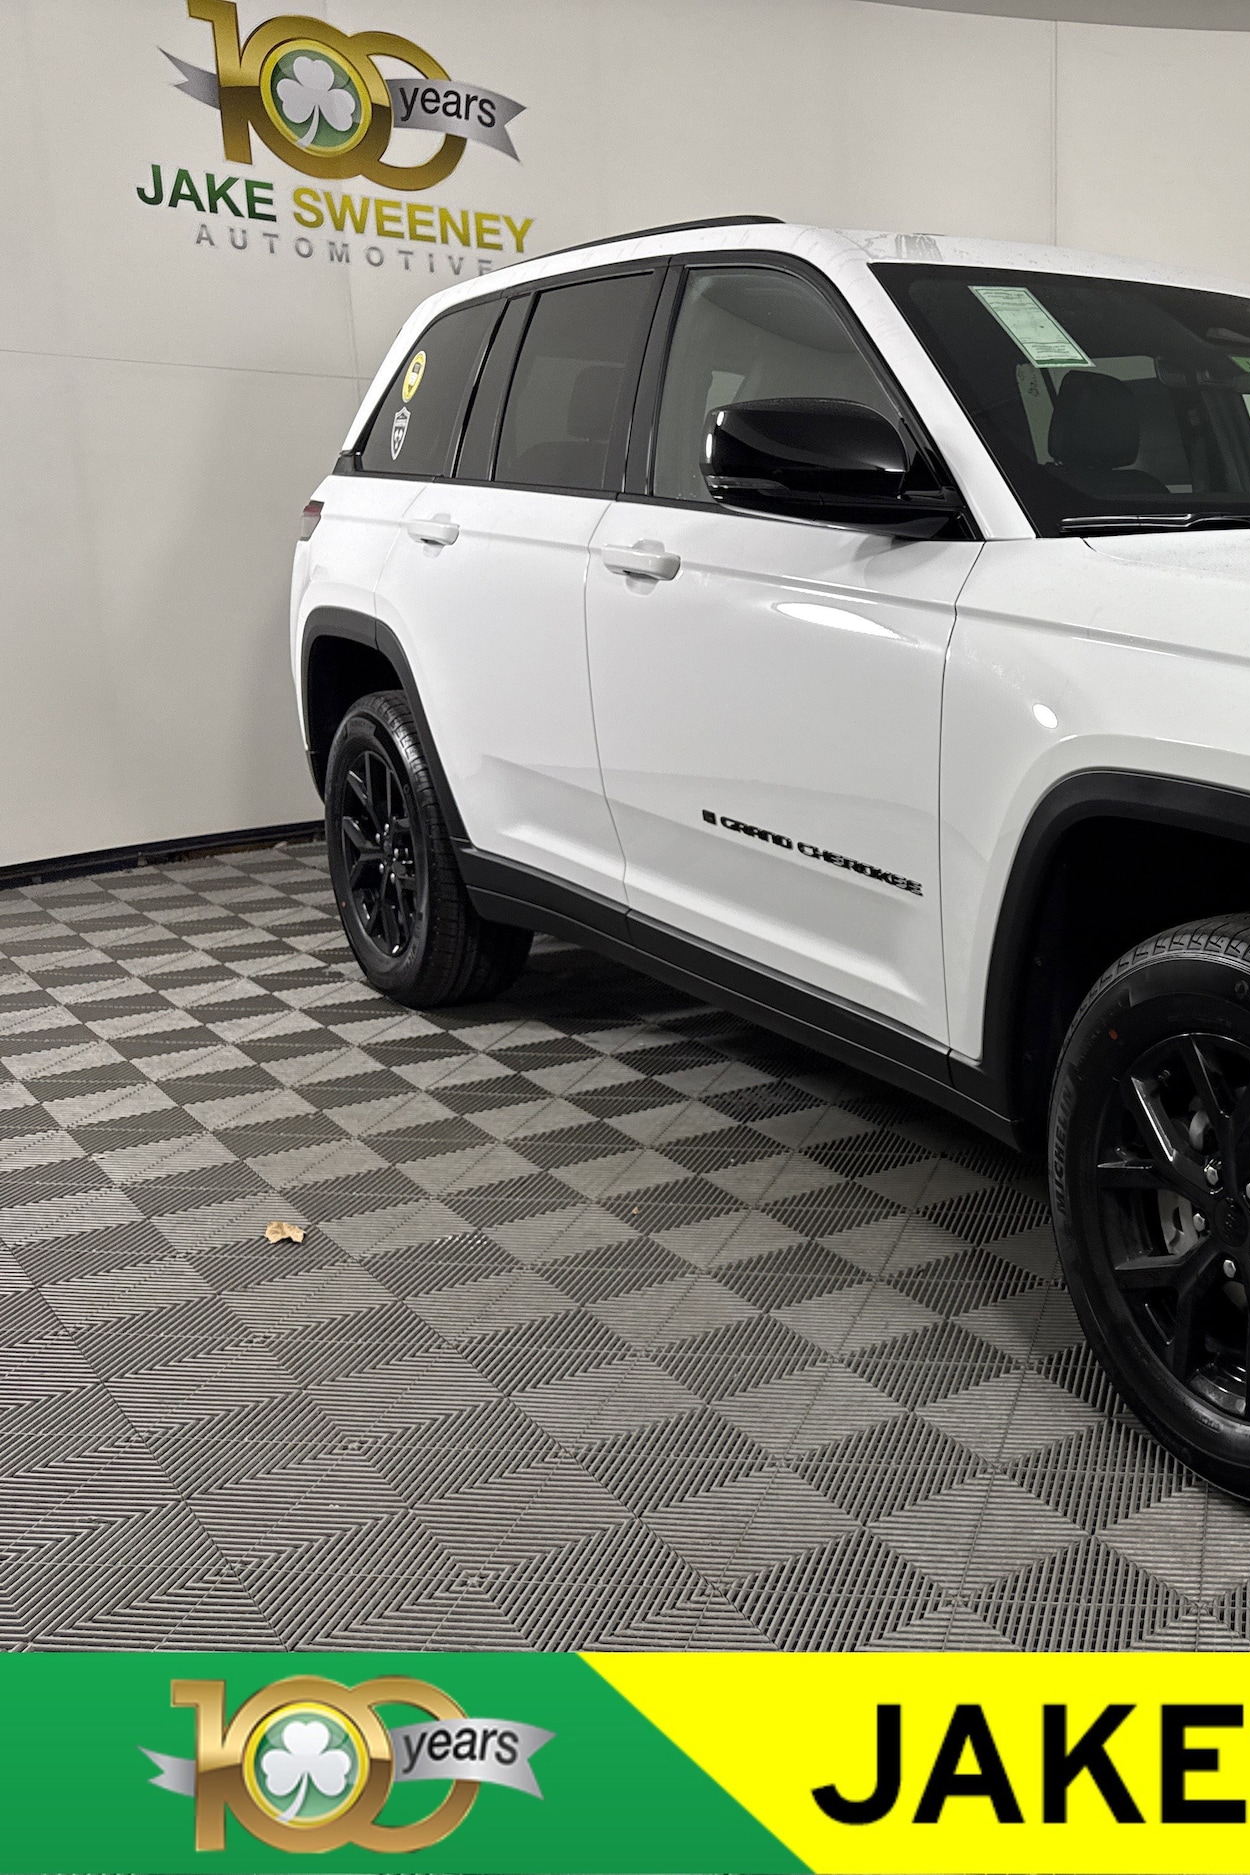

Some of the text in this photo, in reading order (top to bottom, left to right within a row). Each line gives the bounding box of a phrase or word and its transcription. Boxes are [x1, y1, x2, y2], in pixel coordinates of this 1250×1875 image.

[188, 0, 498, 191] 100 years
[136, 164, 535, 254] JAKE SWEENEY
[195, 223, 493, 277] AUTOMOTIVE
[720, 816, 924, 897] GRAND CHEROKEE
[1053, 1082, 1074, 1216] MICHELIN
